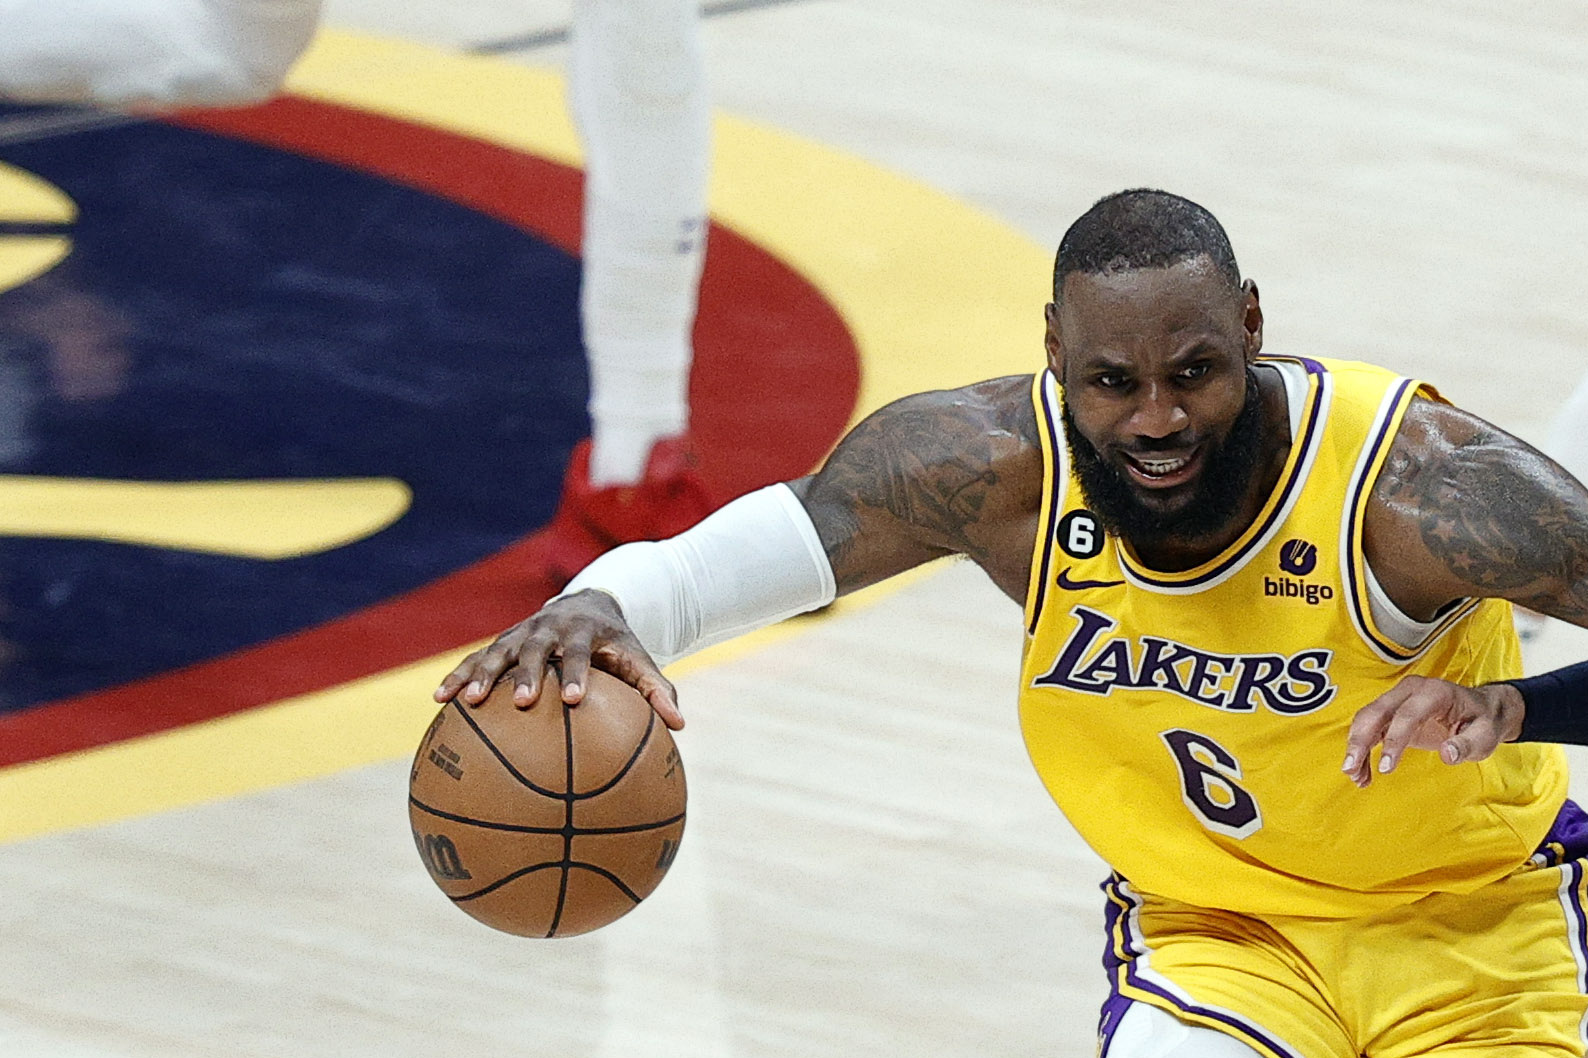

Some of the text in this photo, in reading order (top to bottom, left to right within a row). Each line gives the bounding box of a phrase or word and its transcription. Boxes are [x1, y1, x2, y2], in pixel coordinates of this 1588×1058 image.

[1067, 515, 1096, 554] 6
[1263, 576, 1334, 605] bibigo
[1031, 604, 1339, 717] LAKERS
[1158, 727, 1264, 841] 6
